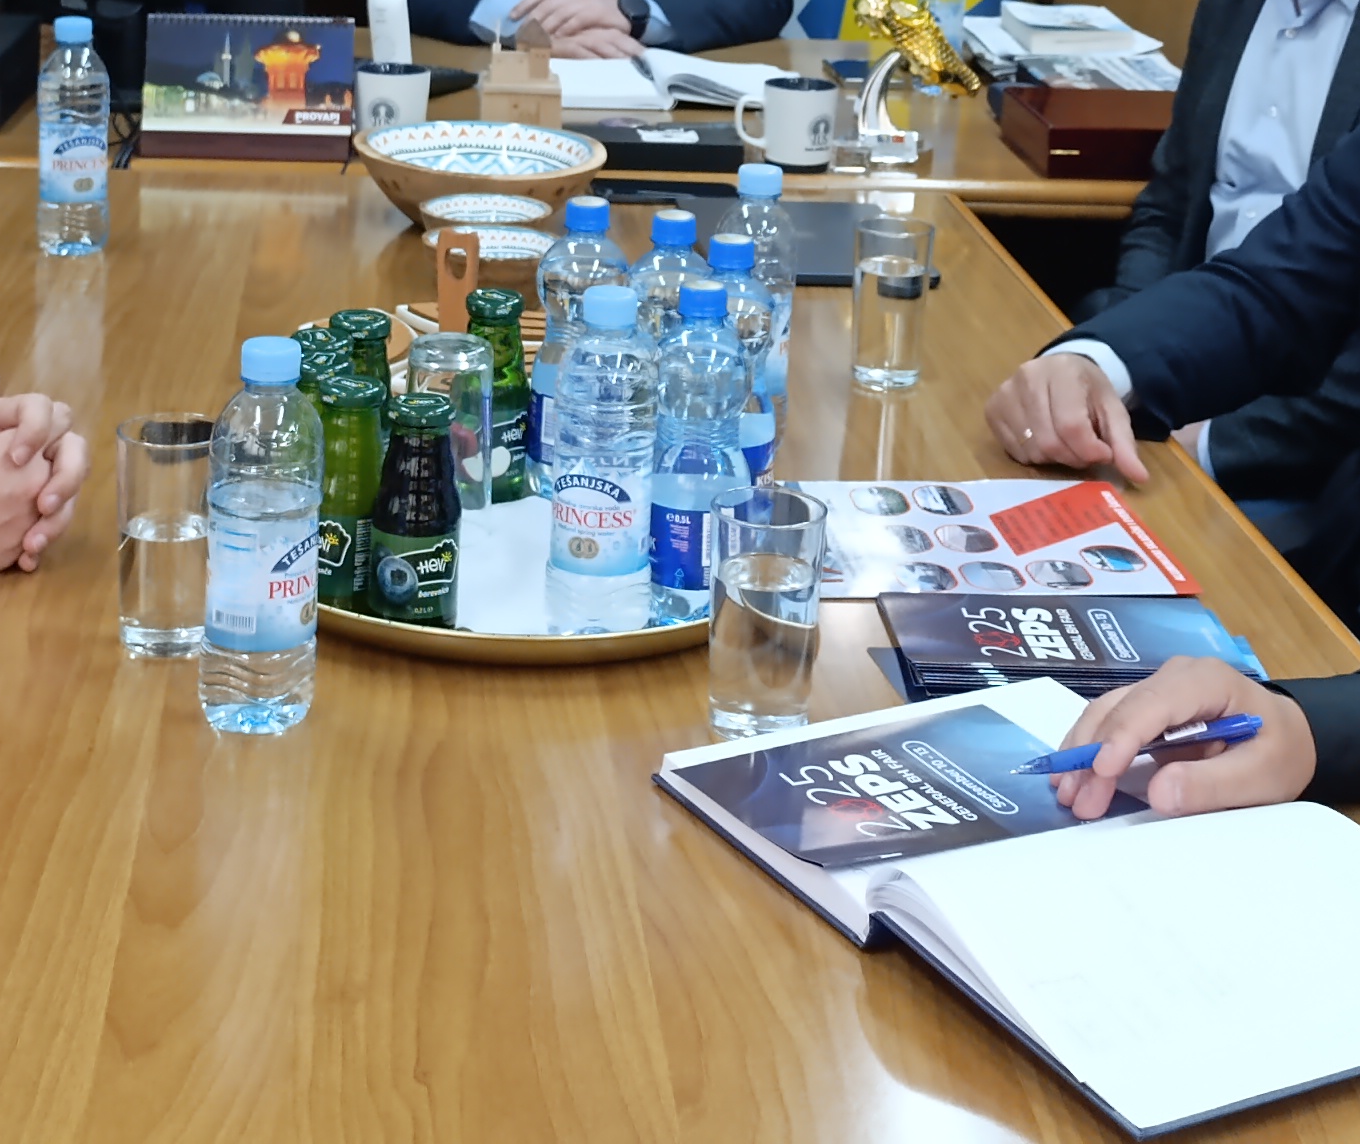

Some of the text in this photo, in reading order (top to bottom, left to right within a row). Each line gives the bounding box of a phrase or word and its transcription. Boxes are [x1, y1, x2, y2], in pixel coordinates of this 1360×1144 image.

[556, 474, 620, 499] TEŠANJSKA
[1010, 607, 1077, 661] ZEPS
[913, 746, 930, 757] 13
[931, 759, 948, 770] 10
[779, 765, 912, 838] 2025
[828, 754, 961, 831] ZEPS
[870, 748, 978, 821] GENERAL BH FAIR
[946, 769, 1007, 809] September
